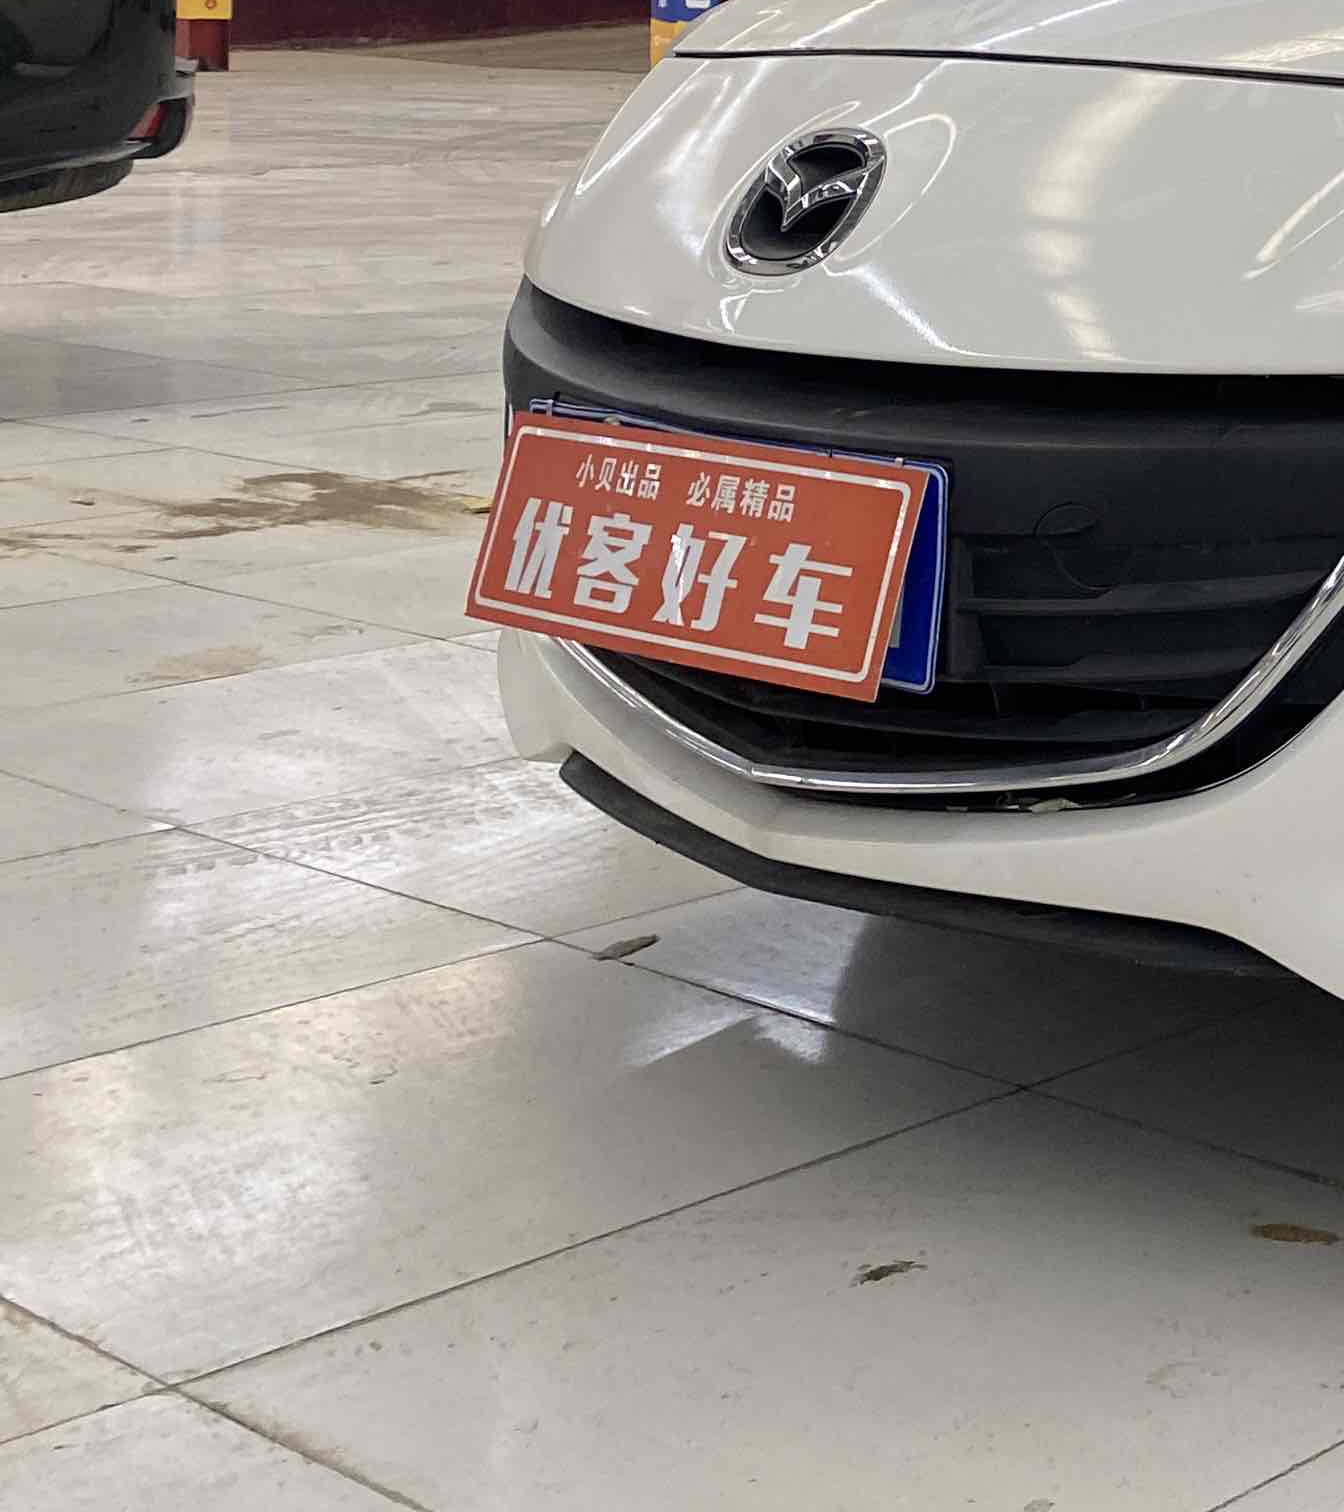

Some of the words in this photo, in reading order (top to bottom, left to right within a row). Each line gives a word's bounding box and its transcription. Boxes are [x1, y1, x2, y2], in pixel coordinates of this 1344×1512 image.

[575, 453, 662, 501] 小贝出品
[686, 471, 796, 523] 必属精品
[504, 497, 853, 650] 优客好车
